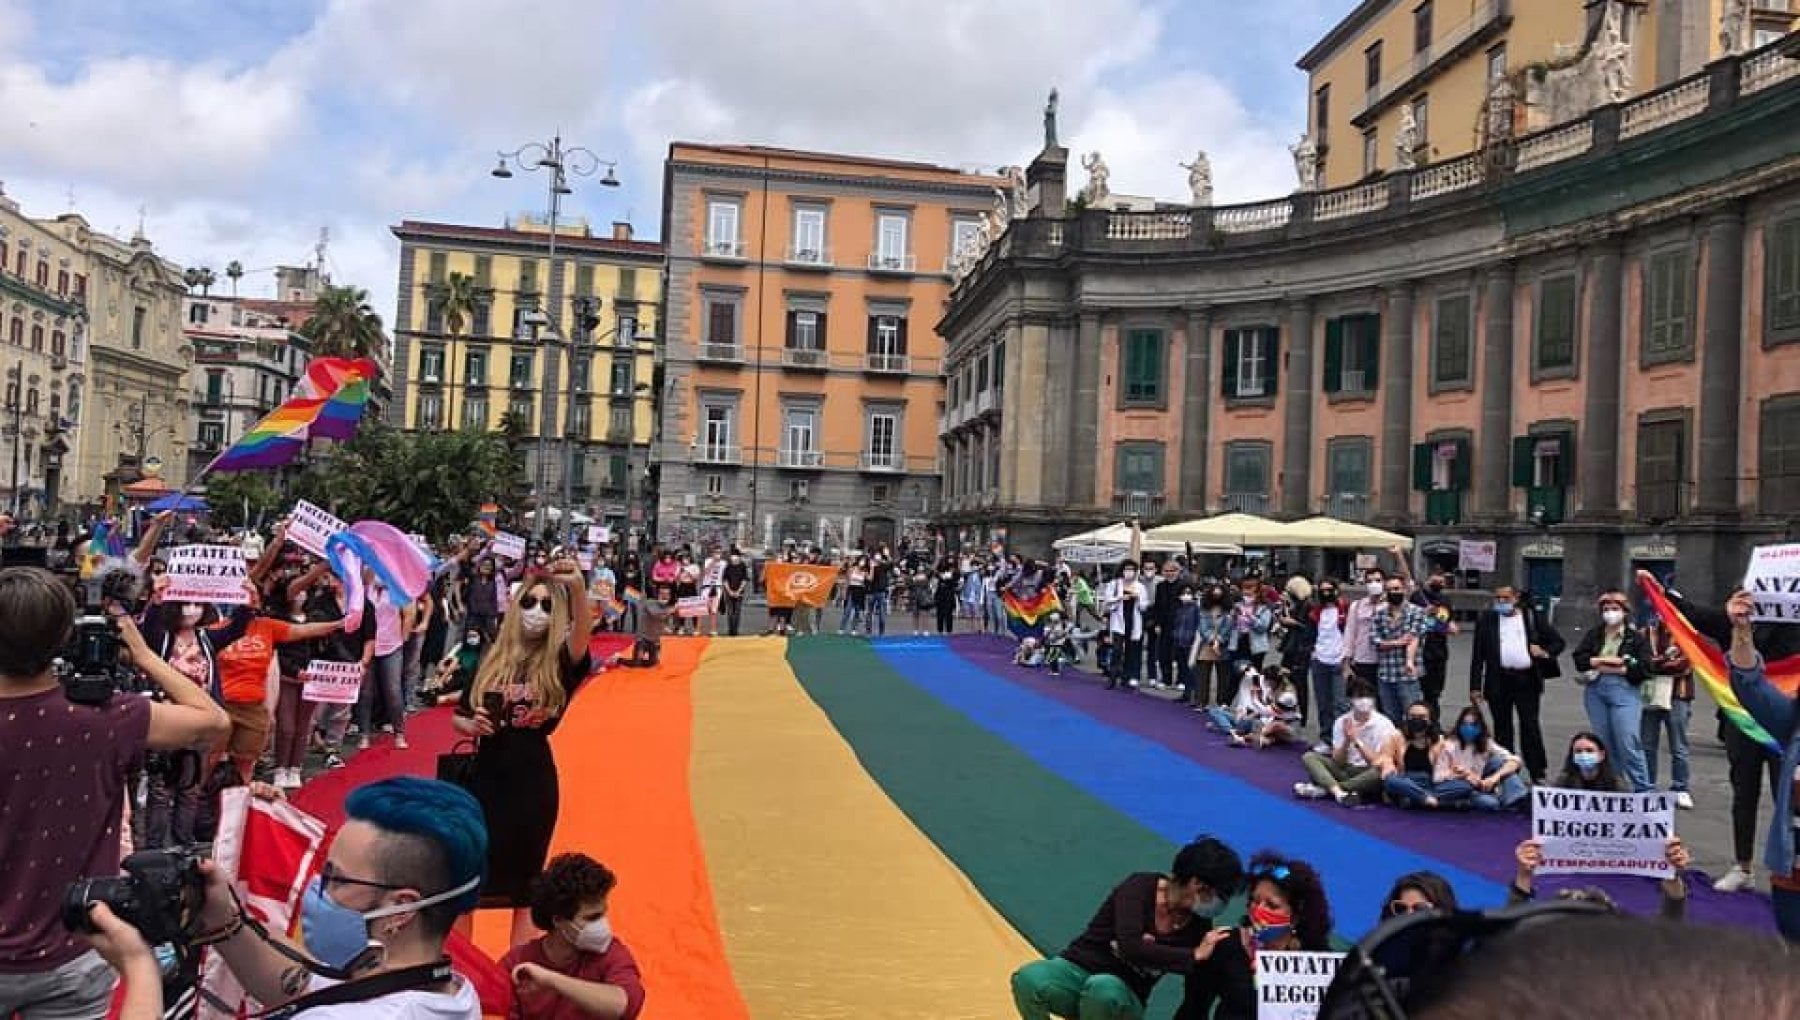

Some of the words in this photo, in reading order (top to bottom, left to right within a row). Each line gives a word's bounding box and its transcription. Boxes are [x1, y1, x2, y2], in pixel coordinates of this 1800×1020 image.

[168, 563, 214, 576] LEGGE
[1537, 790, 1634, 813] VOTATE
[1643, 796, 1668, 813] LA
[1537, 818, 1615, 839] LEGGE
[1621, 822, 1669, 839] ZAN
